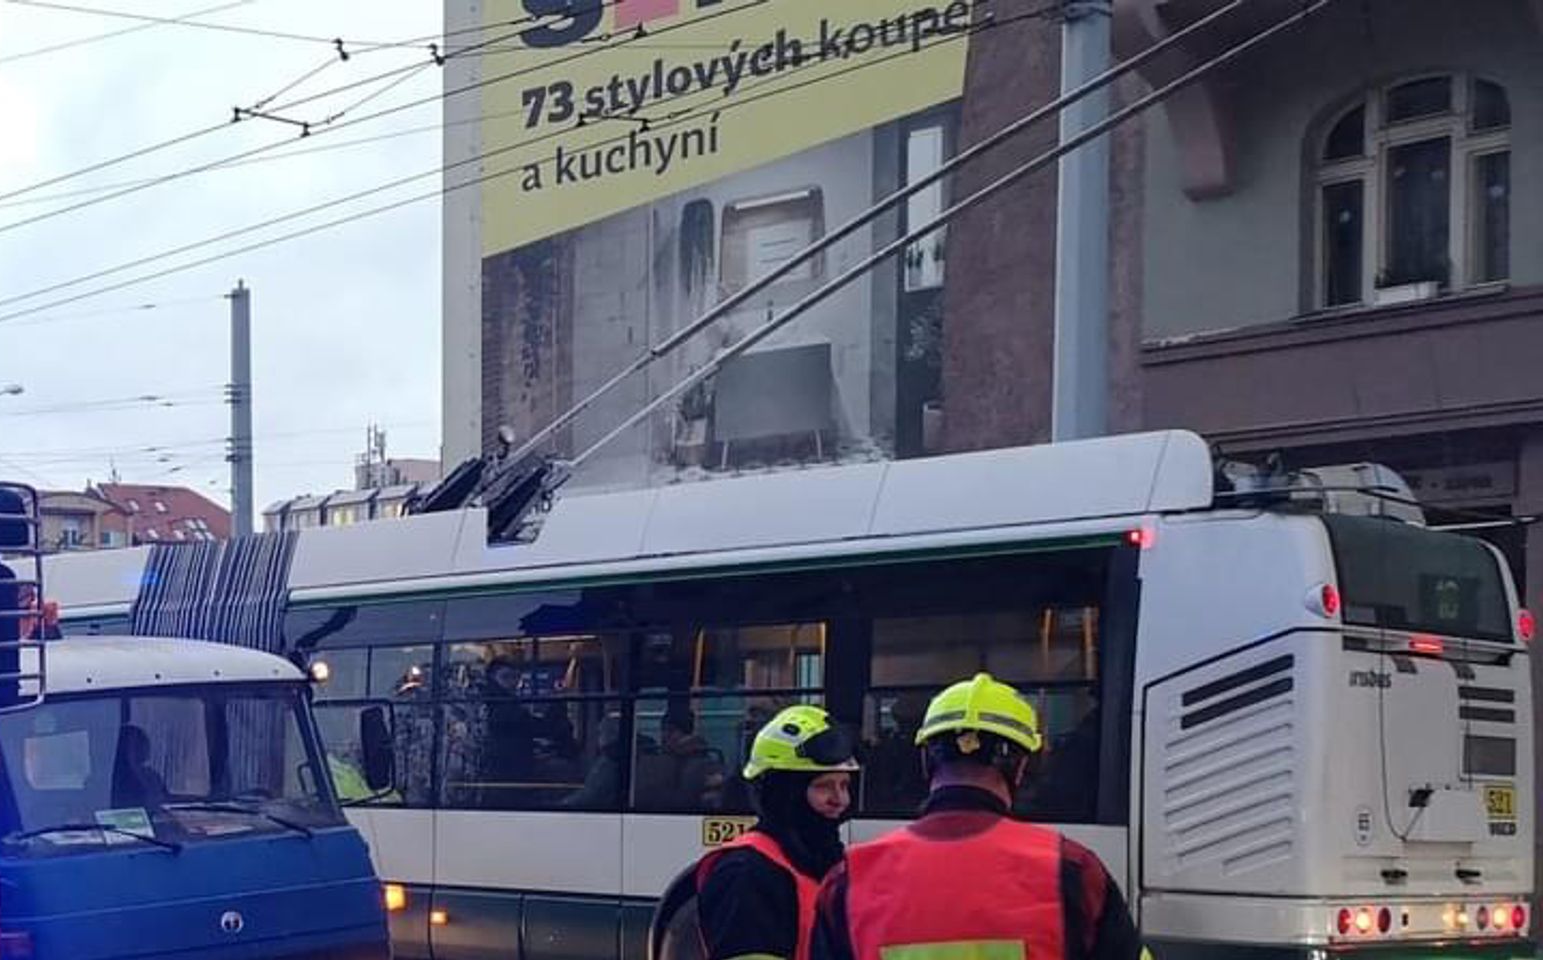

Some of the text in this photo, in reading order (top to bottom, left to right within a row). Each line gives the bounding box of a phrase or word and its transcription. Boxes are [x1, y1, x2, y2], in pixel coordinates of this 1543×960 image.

[521, 80, 574, 129] 73
[585, 28, 803, 117] stylových
[521, 111, 720, 192] a kuchyní
